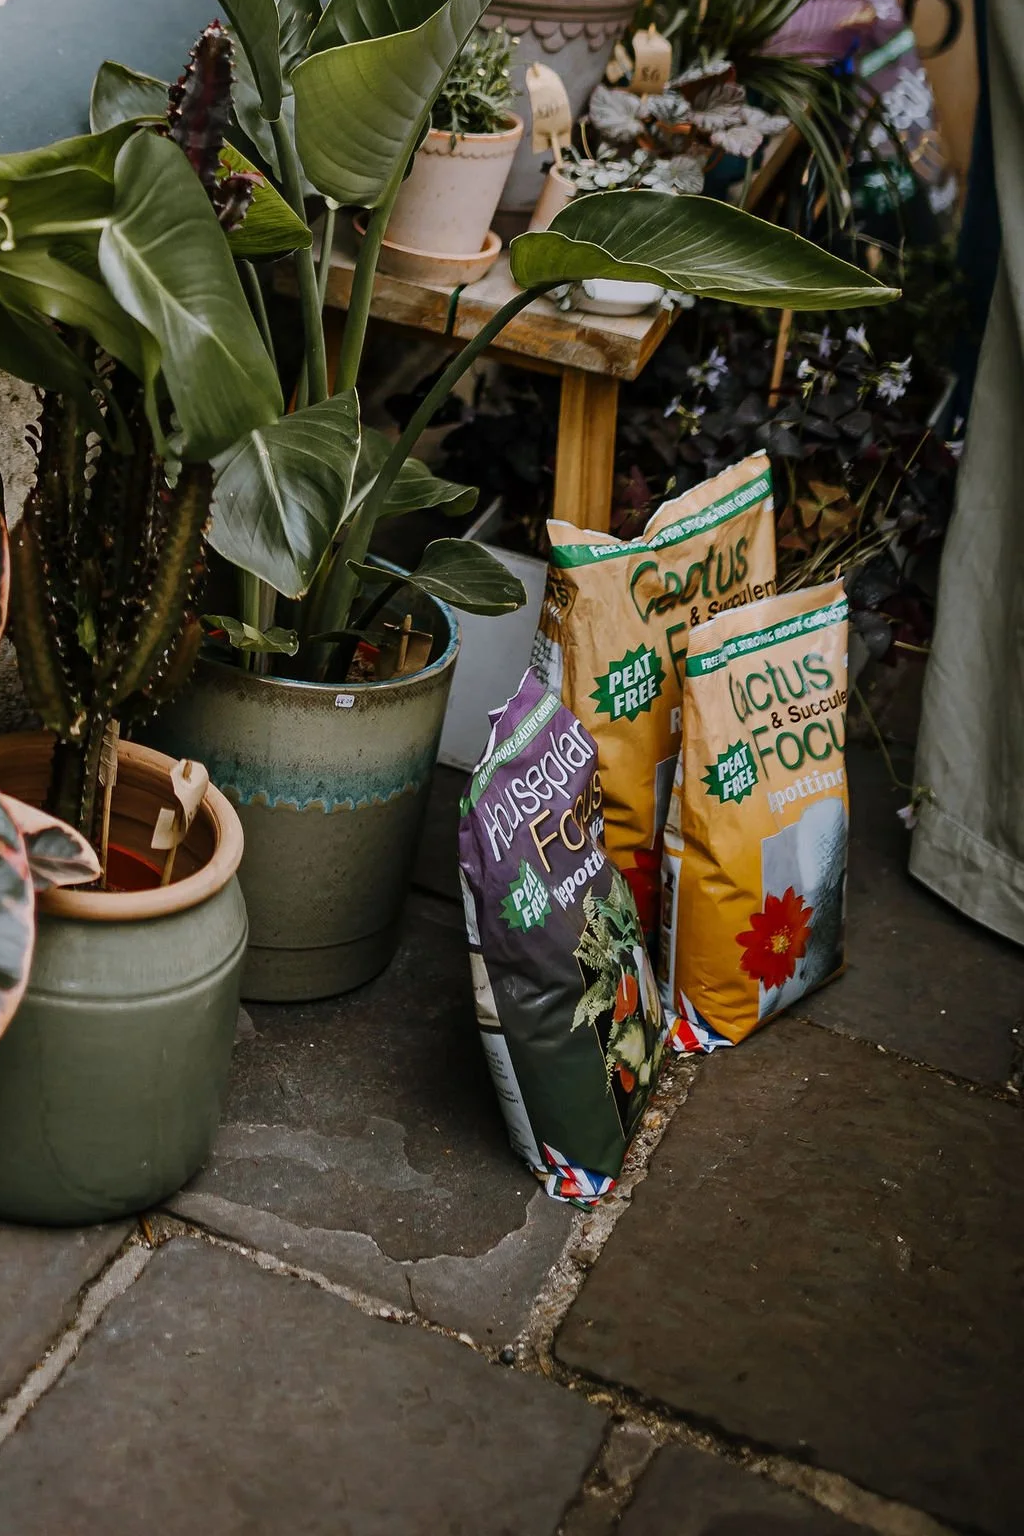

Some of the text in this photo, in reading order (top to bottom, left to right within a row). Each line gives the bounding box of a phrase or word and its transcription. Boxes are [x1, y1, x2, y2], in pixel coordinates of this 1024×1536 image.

[690, 578, 776, 626] & Succulen
[608, 652, 652, 695] PEAT
[613, 675, 657, 717] FREE
[771, 690, 848, 729] & Succule
[717, 746, 748, 782] PEAT
[751, 710, 847, 782] Focu
[482, 719, 594, 862] Houseplan
[723, 765, 756, 800] FREE
[528, 770, 603, 873] Focus
[511, 862, 539, 911] PEAT
[521, 881, 549, 928] FREE
